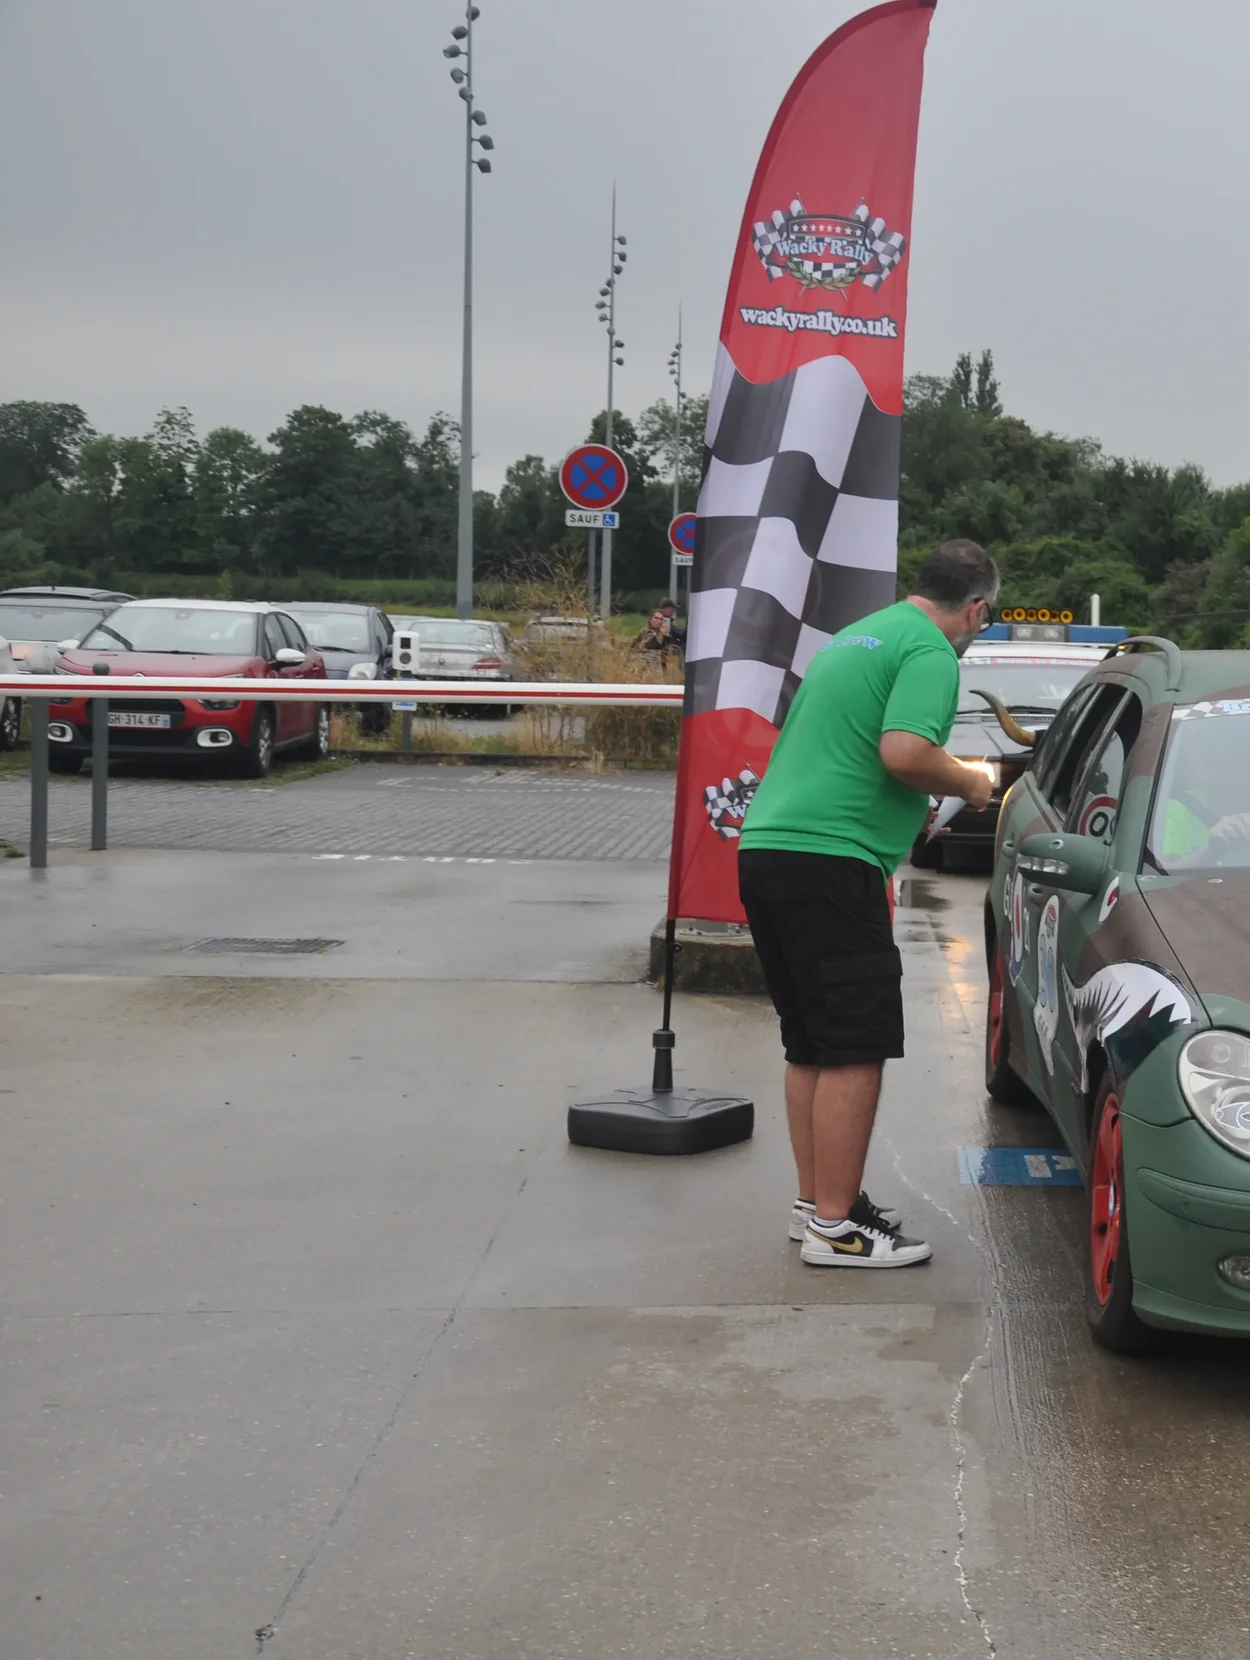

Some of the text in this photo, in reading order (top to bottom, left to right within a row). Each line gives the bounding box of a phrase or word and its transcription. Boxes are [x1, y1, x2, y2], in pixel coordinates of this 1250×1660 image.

[775, 238, 874, 265] Wacky Rally
[740, 306, 898, 337] wackyrally.co.uk
[569, 513, 600, 524] SAUF
